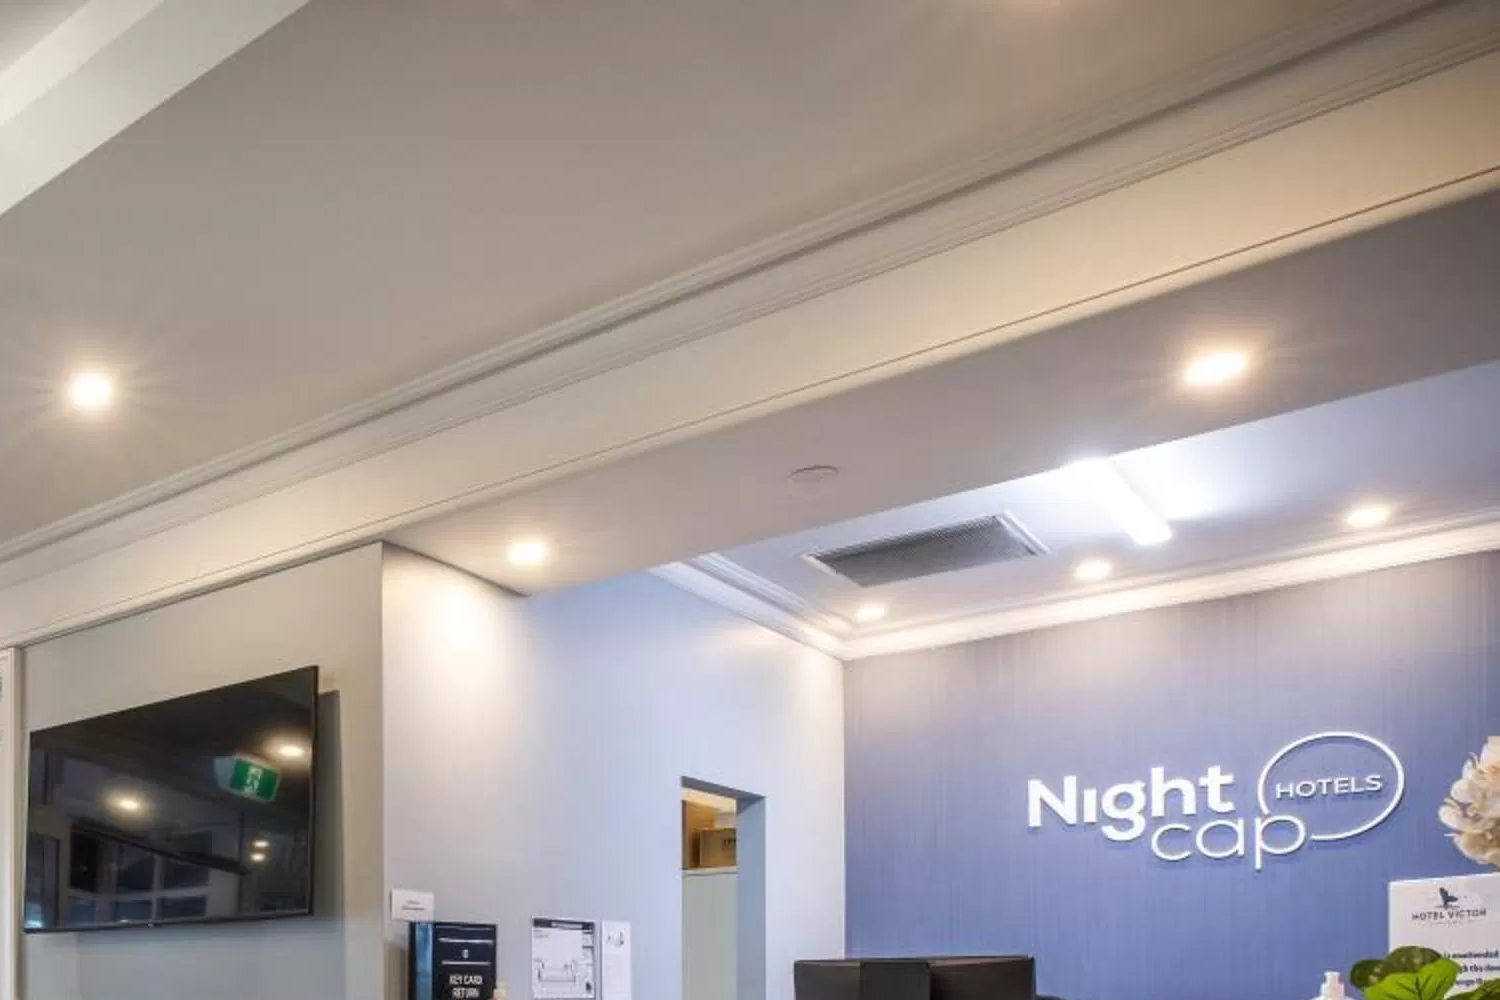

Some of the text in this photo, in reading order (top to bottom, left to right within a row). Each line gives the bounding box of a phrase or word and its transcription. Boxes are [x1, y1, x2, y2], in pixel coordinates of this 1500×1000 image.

[1275, 774, 1383, 799] HOTELS
[1027, 764, 1236, 842] Night
[1150, 815, 1306, 871] cap
[1412, 911, 1445, 921] HOTEL
[449, 974, 483, 985] KEY CARD
[452, 987, 480, 999] RETURN
